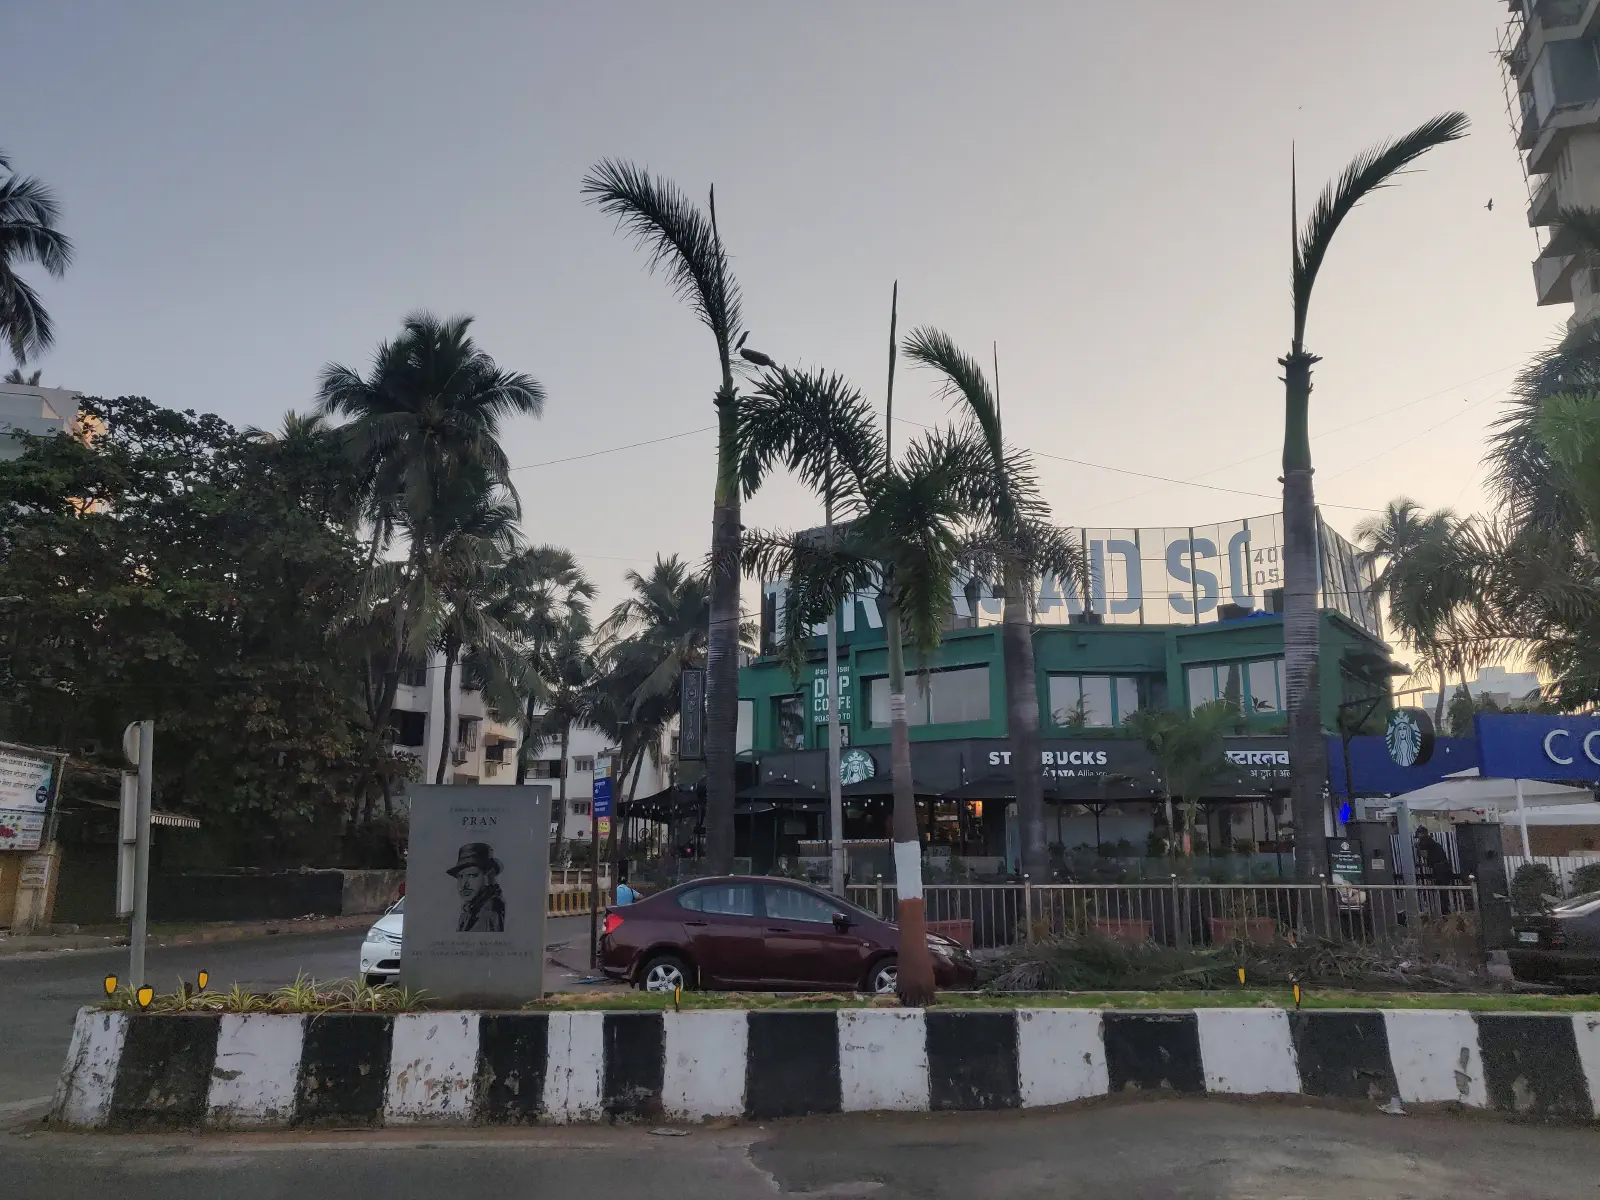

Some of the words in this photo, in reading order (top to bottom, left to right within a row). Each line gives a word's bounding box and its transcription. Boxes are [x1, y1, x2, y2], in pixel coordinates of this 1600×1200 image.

[814, 696, 850, 711] COFE
[989, 751, 1108, 766] STBUCKS
[1051, 769, 1075, 777] TATA
[461, 816, 498, 826] PRAN
